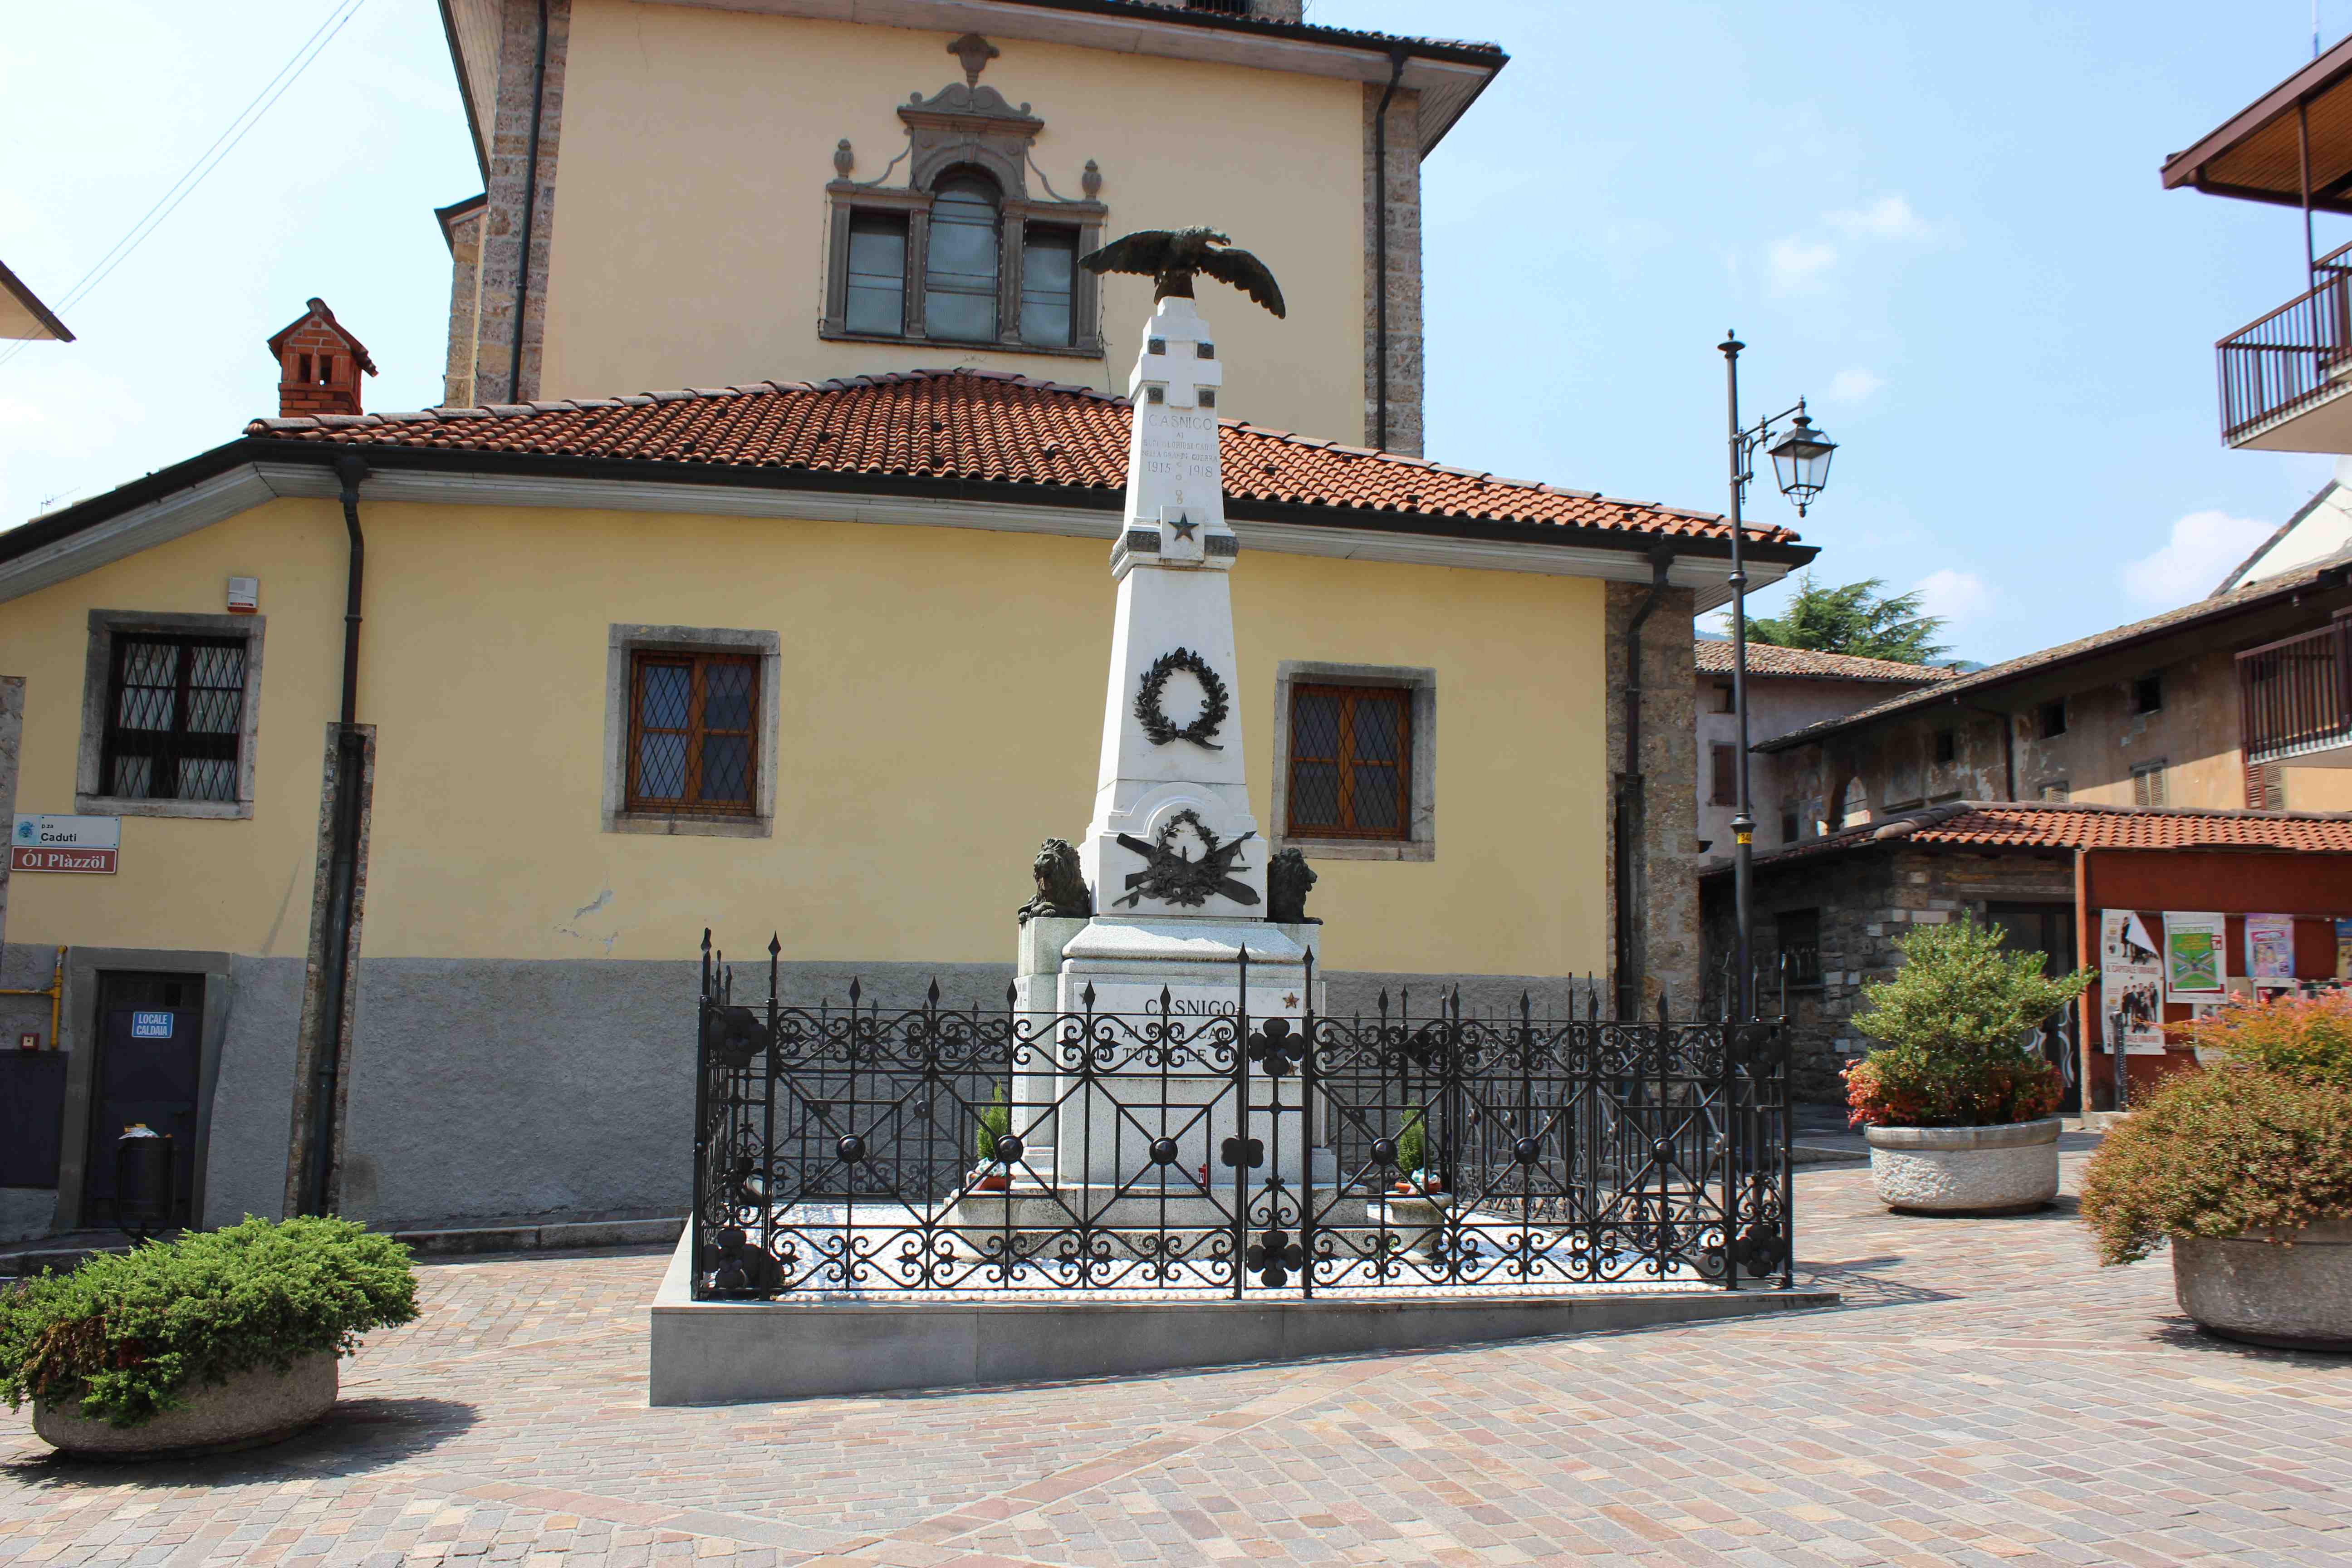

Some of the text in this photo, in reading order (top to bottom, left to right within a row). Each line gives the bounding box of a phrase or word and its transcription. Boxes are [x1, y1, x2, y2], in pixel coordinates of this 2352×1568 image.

[1147, 461, 1213, 477] 1915 1918
[40, 833, 77, 842] Caduti
[22, 849, 105, 868] Ól Plàzzöl
[138, 1014, 167, 1024] LOCALE
[137, 1025, 167, 1036] CALDAIA
[1148, 1026, 1185, 1039] SOI
